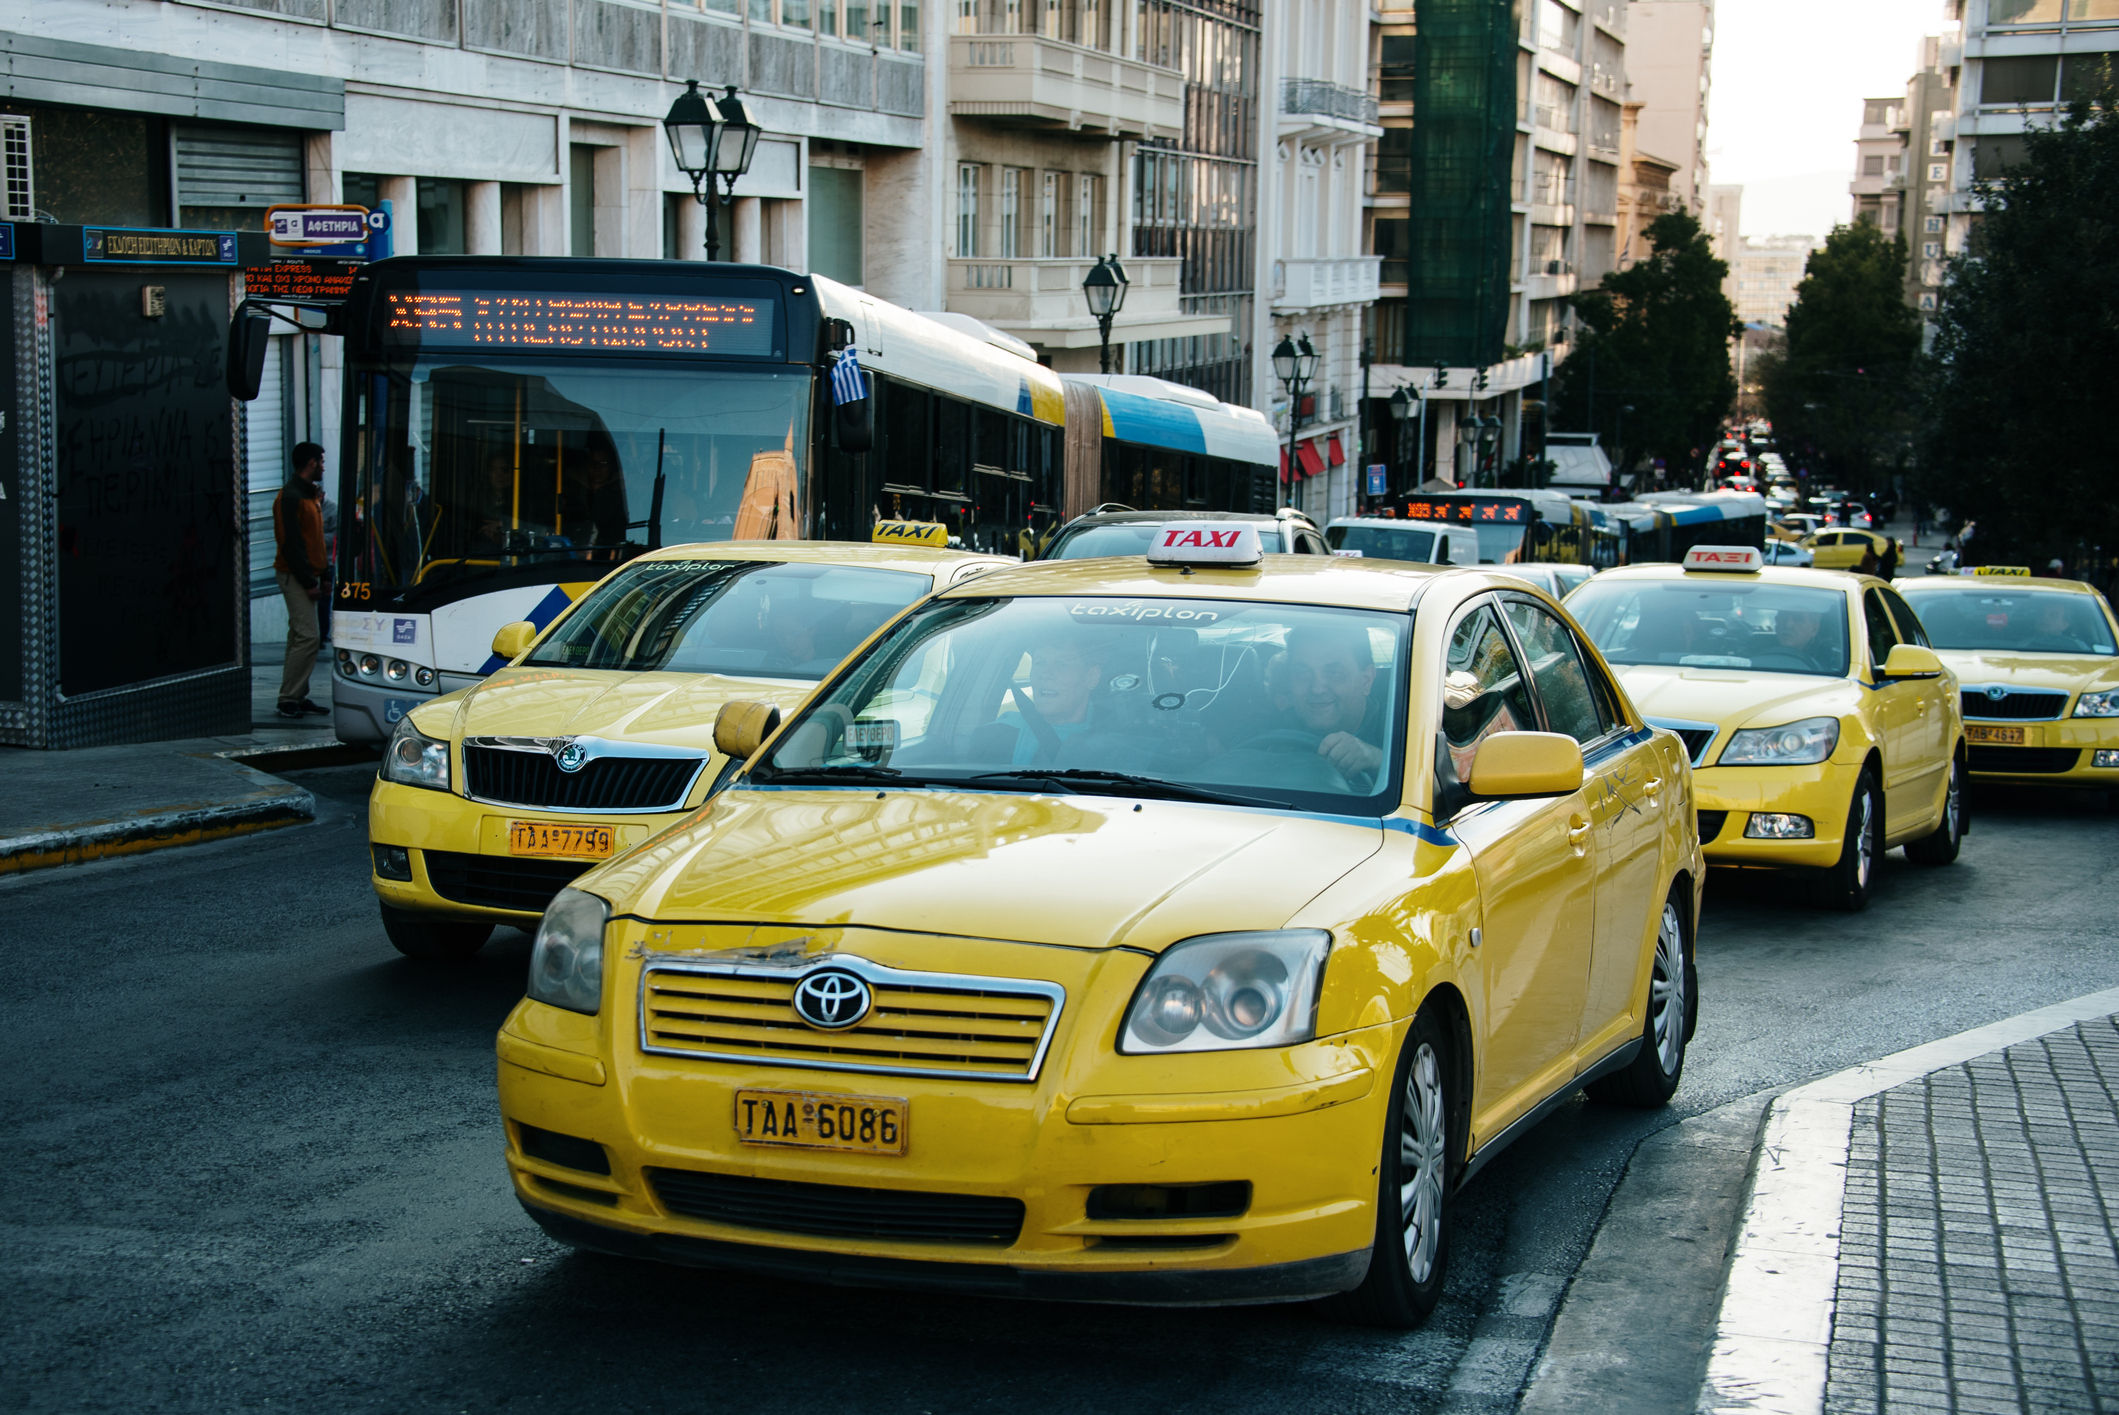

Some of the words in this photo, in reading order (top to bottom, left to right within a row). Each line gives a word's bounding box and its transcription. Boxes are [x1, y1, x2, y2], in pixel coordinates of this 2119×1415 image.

[307, 220, 360, 233] ΑΦΕΤΗΡΙΑ
[274, 264, 312, 274] EXPRESS
[876, 522, 938, 539] TAXI
[1163, 530, 1242, 548] TAXI
[1690, 552, 1751, 563] ΤΑΞΙ
[1988, 568, 2027, 576] TAXI
[1070, 601, 1218, 621] taxiplon
[848, 726, 894, 742] ΕΛΕΥΘΕΡΟ
